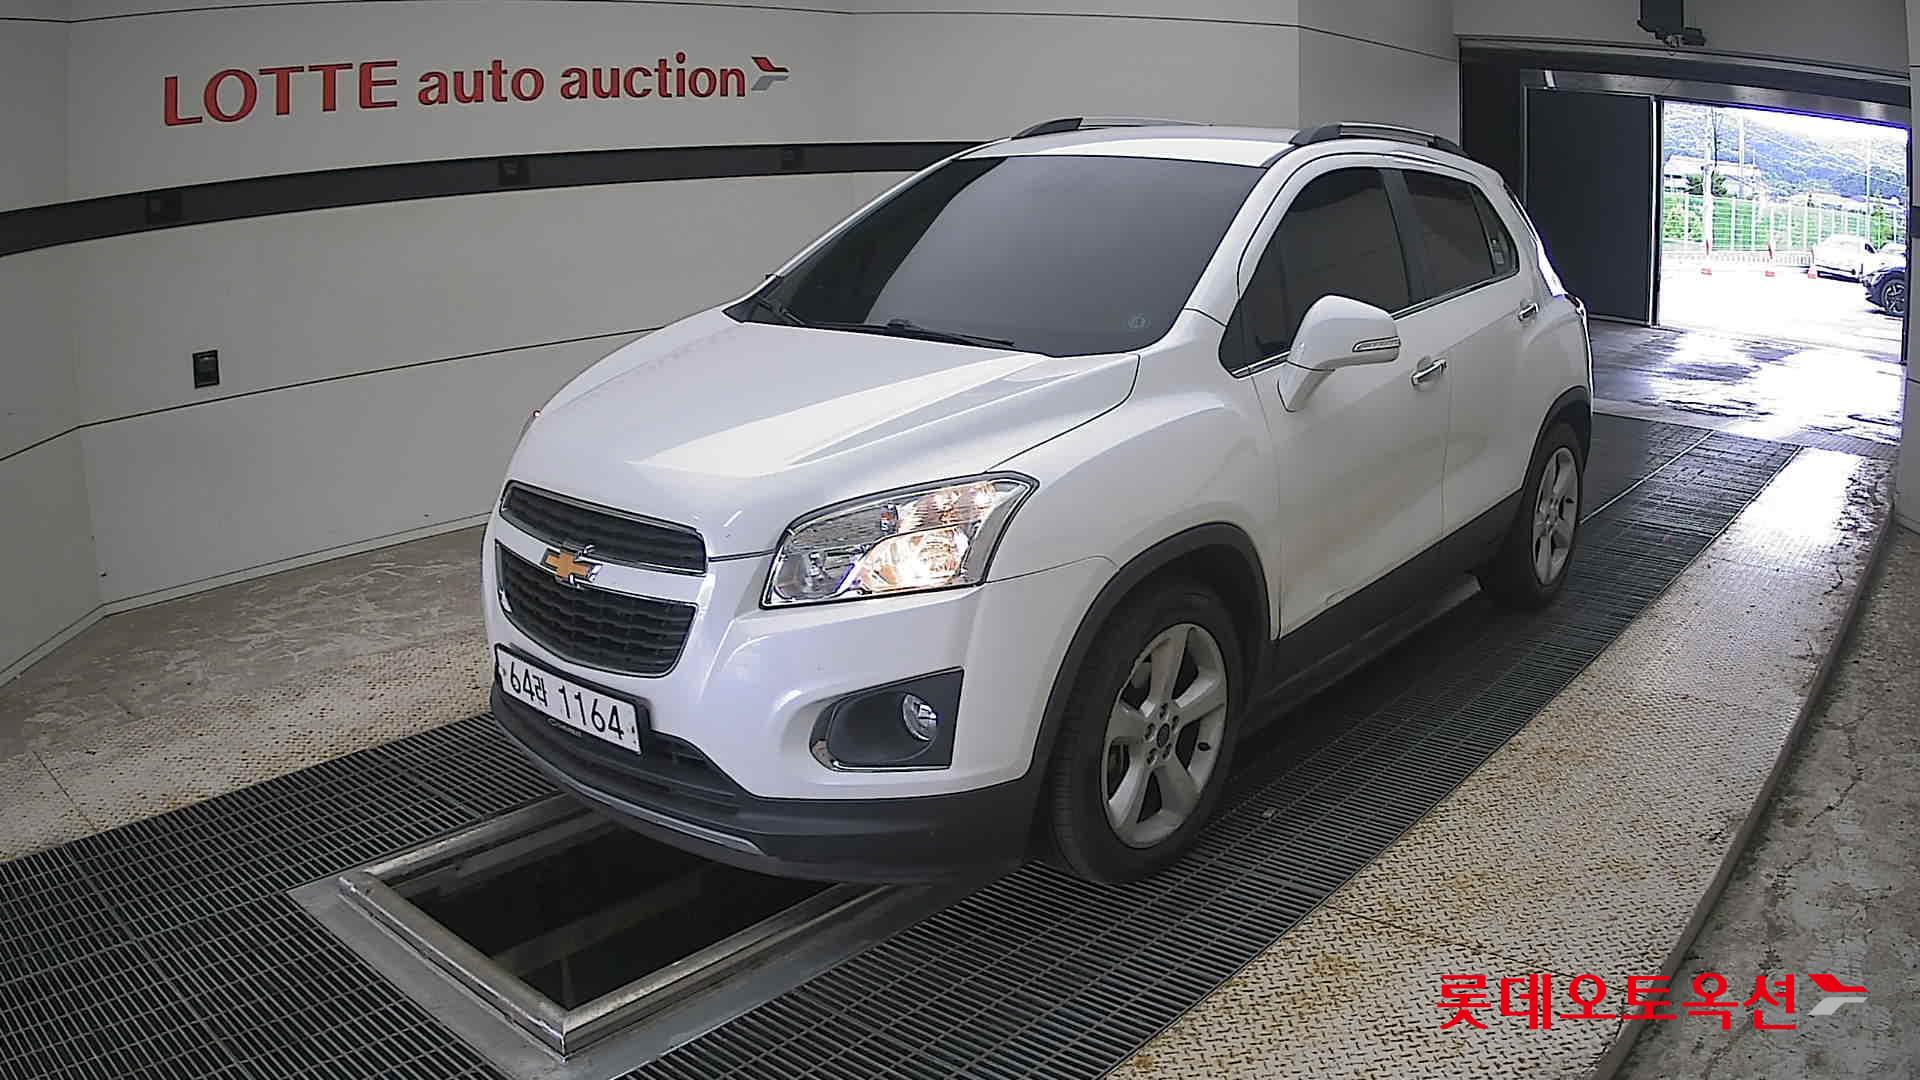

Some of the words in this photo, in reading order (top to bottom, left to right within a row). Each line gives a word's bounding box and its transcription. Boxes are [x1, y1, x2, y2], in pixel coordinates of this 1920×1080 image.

[163, 60, 398, 126] LOTTE
[418, 60, 544, 105] auto
[560, 51, 745, 98] auction
[510, 661, 548, 707] 64라
[558, 684, 625, 740] 1164
